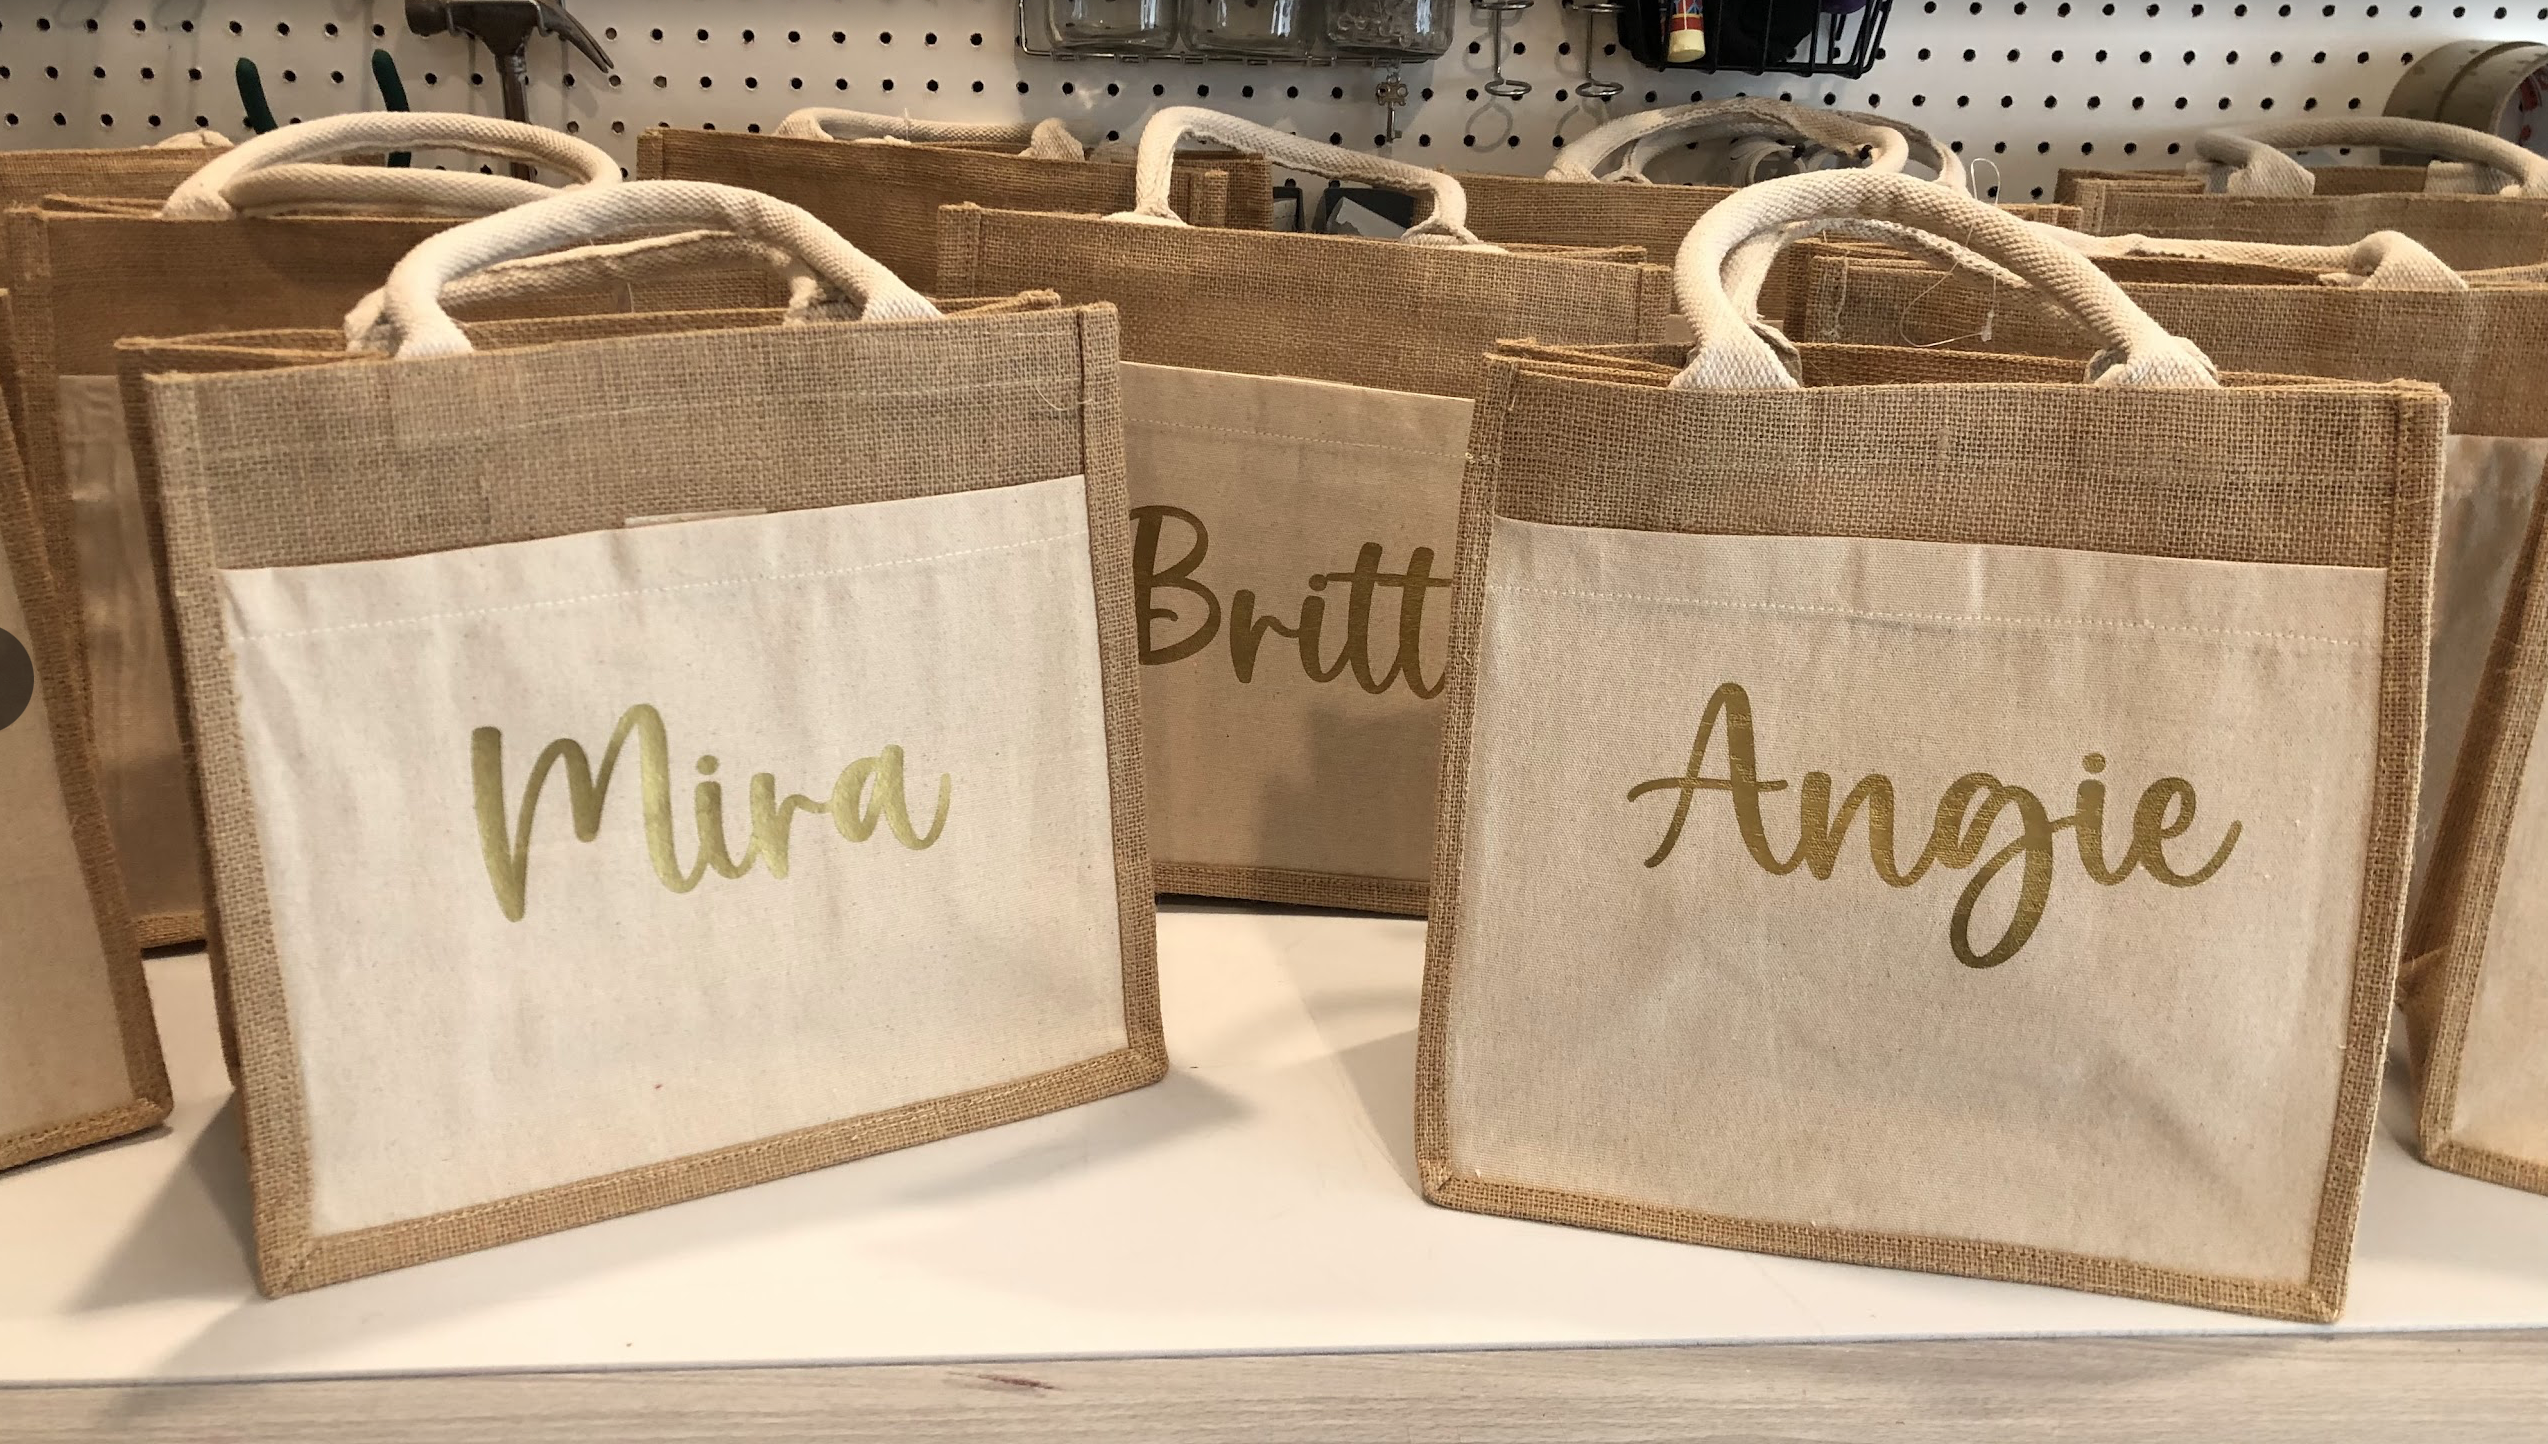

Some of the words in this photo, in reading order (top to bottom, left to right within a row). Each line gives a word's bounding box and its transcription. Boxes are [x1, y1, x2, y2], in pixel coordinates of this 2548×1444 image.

[1130, 505, 1453, 700] Britt
[472, 703, 951, 922] Mira
[1627, 682, 2243, 969] Angie
